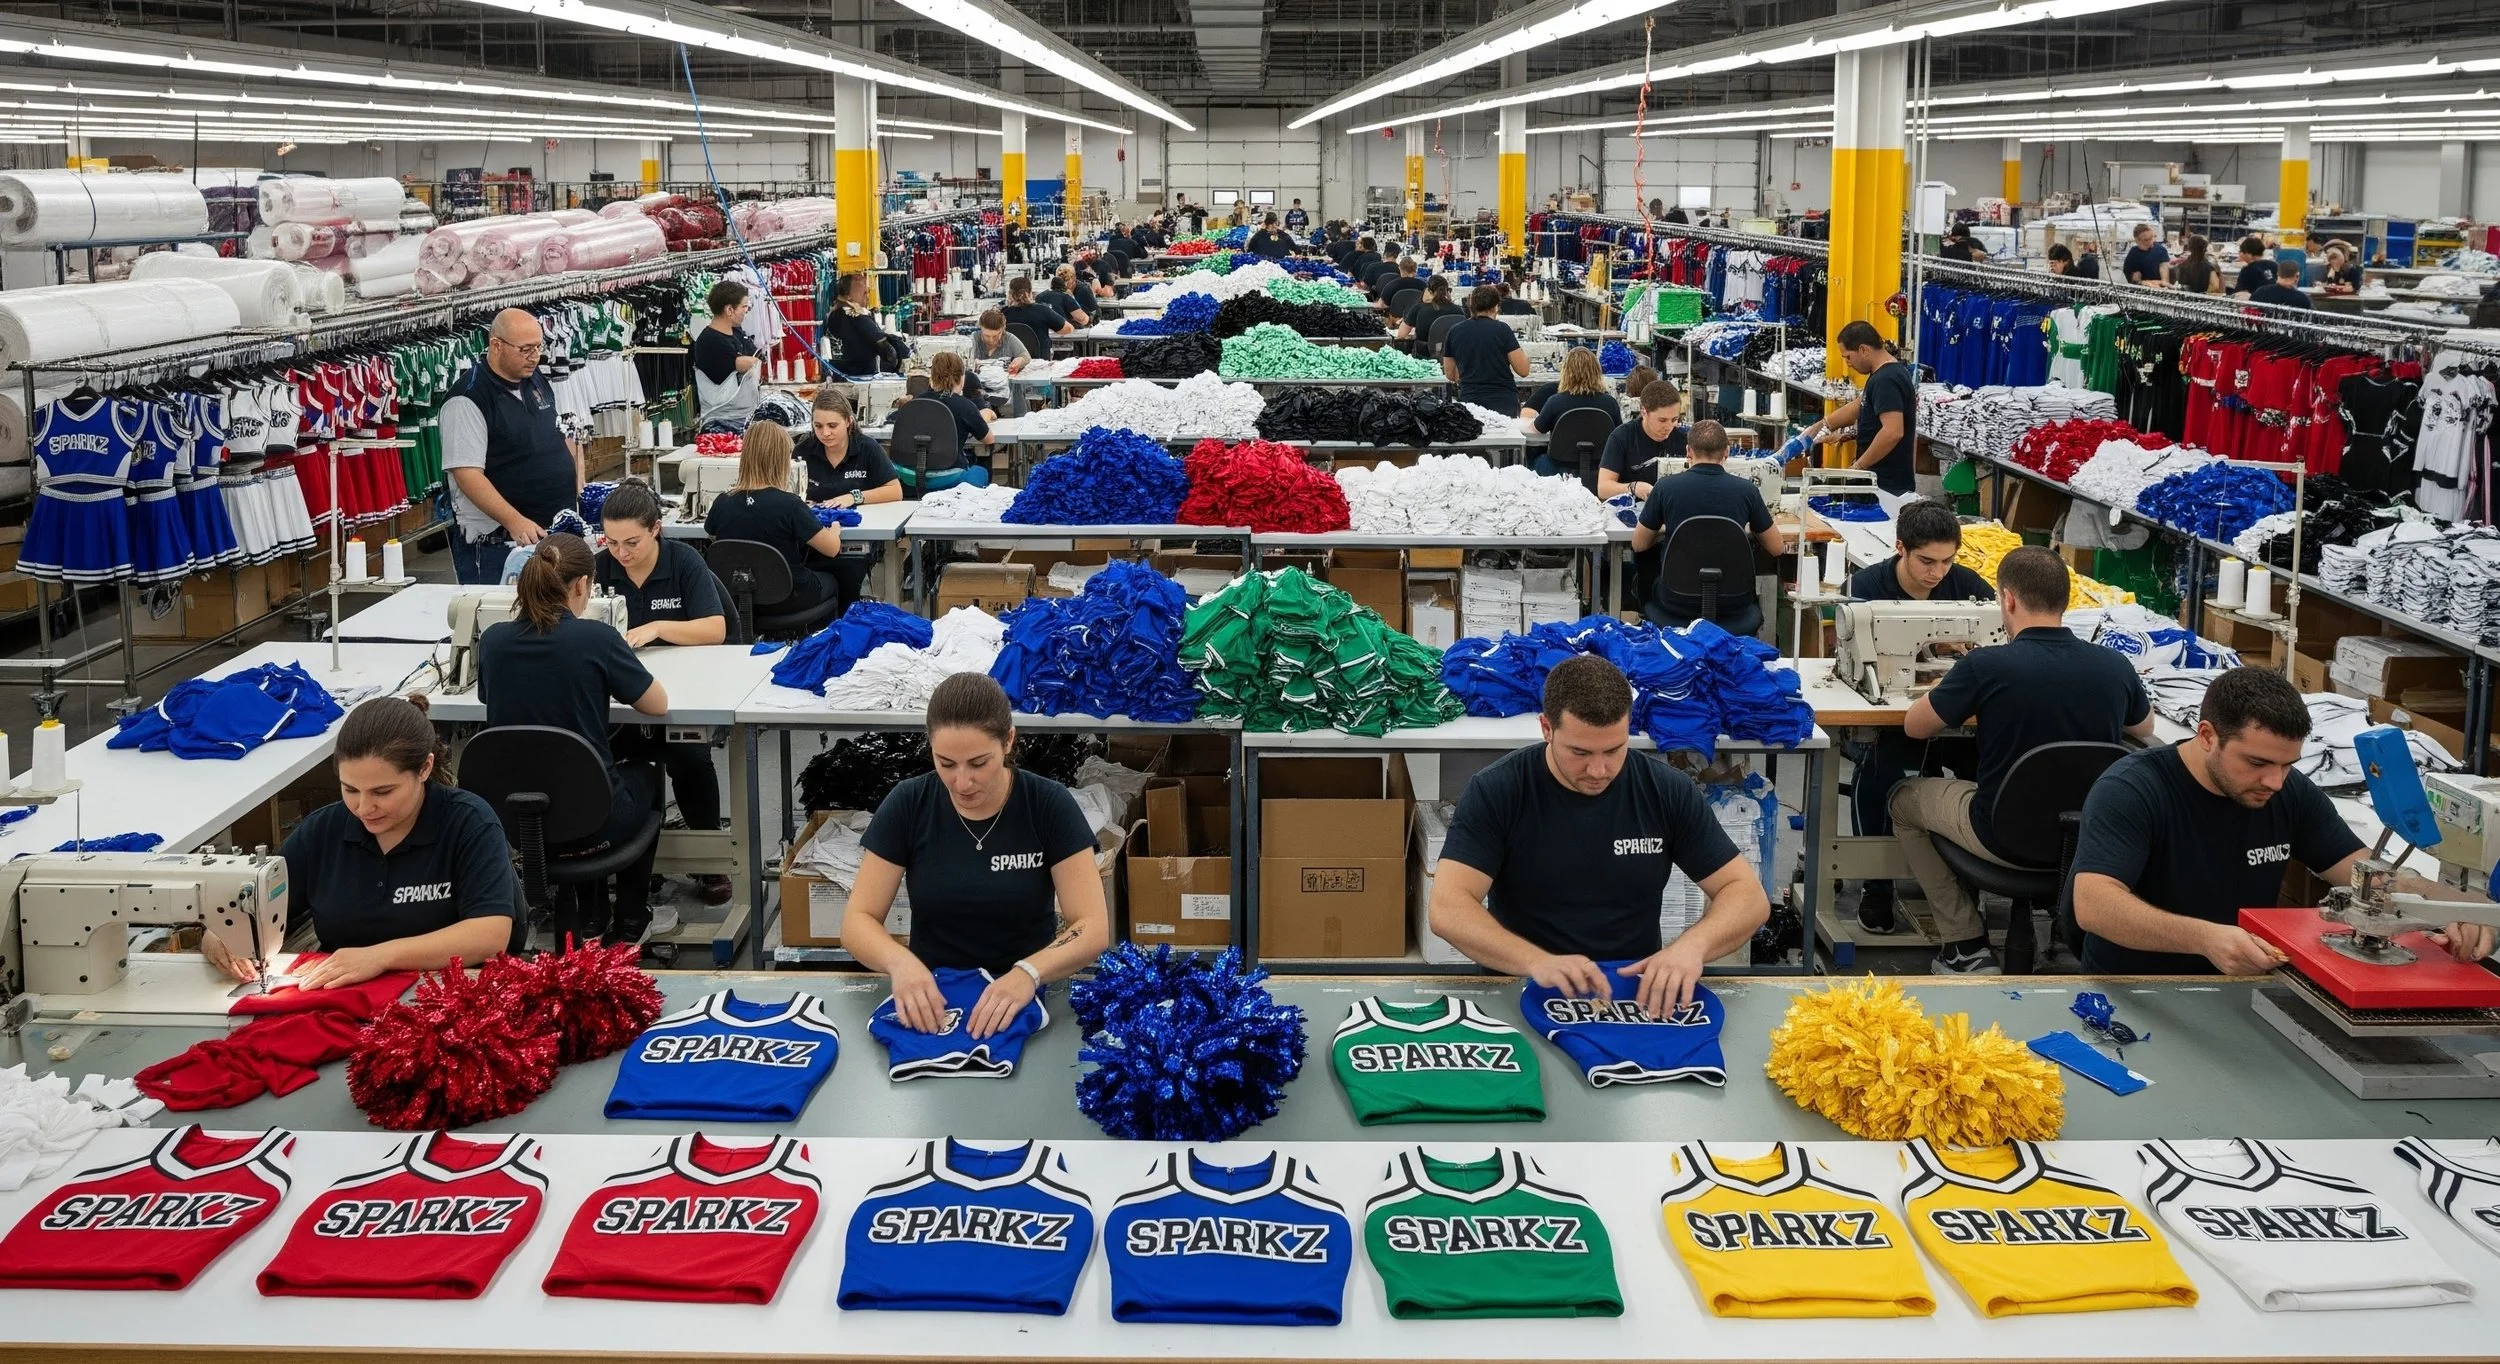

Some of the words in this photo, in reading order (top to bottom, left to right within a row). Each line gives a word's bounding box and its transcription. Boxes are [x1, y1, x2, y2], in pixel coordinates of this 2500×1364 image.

[1543, 998, 1711, 1027] SPARZ
[640, 1034, 820, 1068] SPARKZ
[1348, 1042, 1523, 1074] SPARKZ
[41, 1193, 267, 1231] SPARKZ
[314, 1196, 528, 1238] SPARKZ
[592, 1197, 802, 1235] SPARKZ
[868, 1205, 1074, 1251] SPARKZ
[1683, 1209, 1893, 1252] SPARKZ
[1928, 1205, 2150, 1247] SPARKZ
[2180, 1203, 2409, 1242] SPARKZ
[1126, 1216, 1331, 1262] SPARKZ
[1385, 1214, 1589, 1254] SPARKZ
